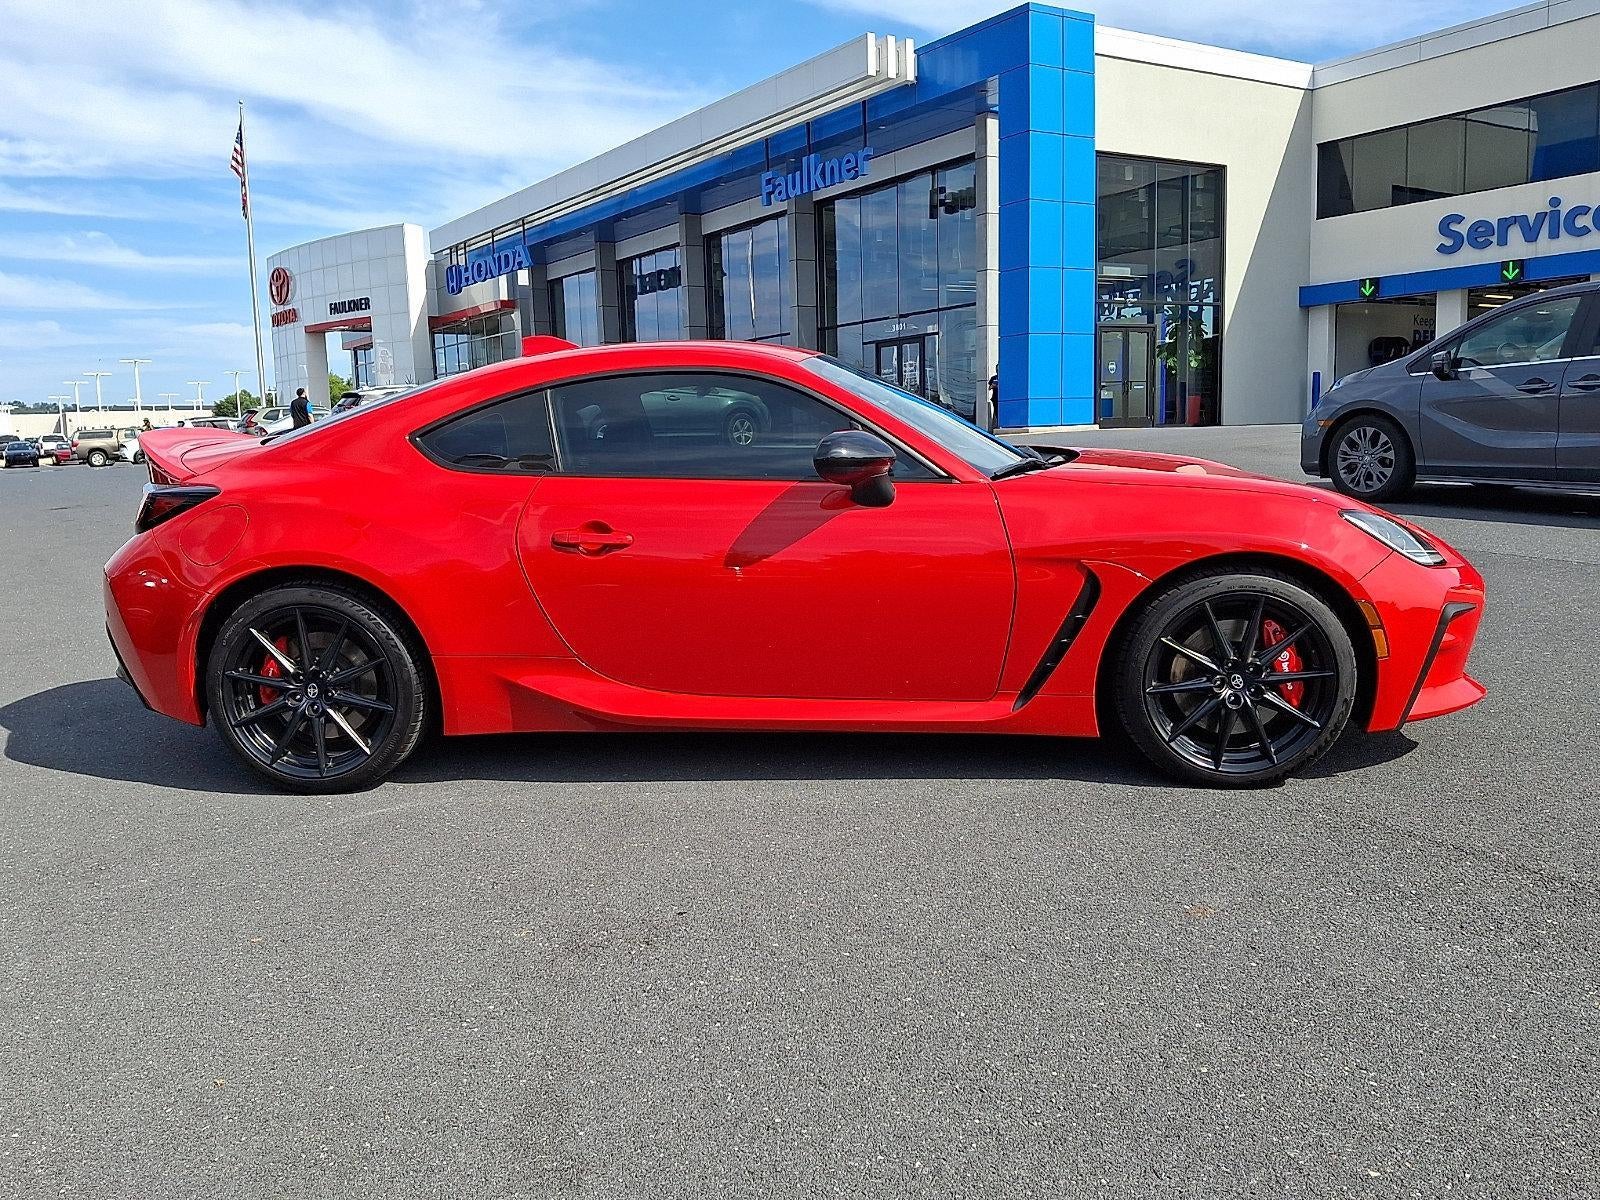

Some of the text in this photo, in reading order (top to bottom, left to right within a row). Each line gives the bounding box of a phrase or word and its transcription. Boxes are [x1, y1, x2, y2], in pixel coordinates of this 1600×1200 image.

[761, 147, 874, 206] Faulkner
[460, 245, 533, 287] HONDA
[272, 308, 298, 328] TOYOTA
[329, 297, 371, 315] FAULKNER
